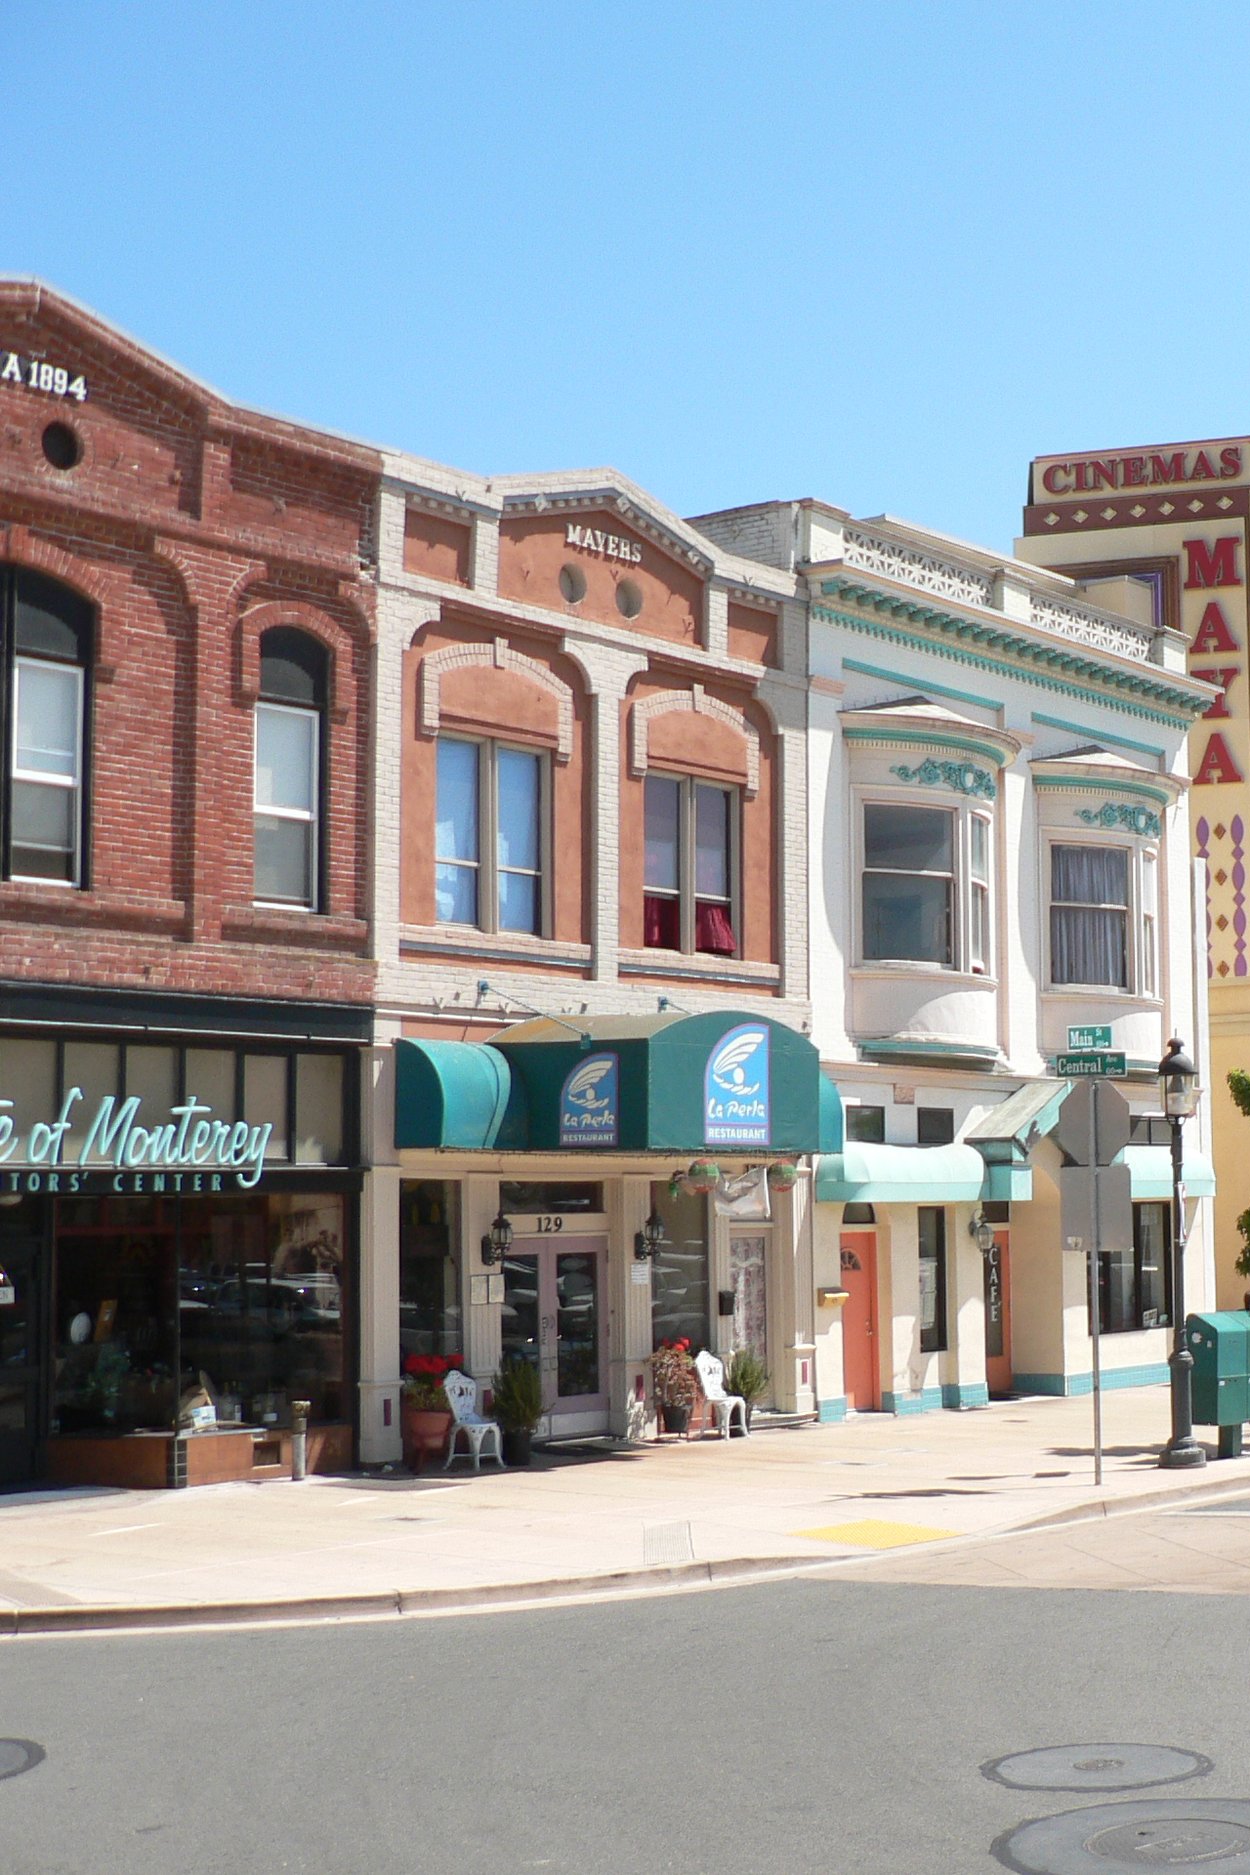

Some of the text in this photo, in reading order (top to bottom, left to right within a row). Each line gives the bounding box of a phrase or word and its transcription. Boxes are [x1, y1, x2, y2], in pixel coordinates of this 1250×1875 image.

[2, 352, 87, 402] A 1894
[1042, 447, 1243, 494] CINEMAS
[566, 522, 642, 563] MAYERS
[1182, 536, 1244, 785] MAYA
[1070, 1030, 1093, 1046] Main
[1058, 1057, 1102, 1073] Central
[707, 1098, 765, 1118] La Perla
[564, 1110, 615, 1128] La Perla
[27, 1086, 84, 1166] of
[78, 1095, 273, 1188] Monterey
[562, 1133, 614, 1142] RESTAURANT
[708, 1127, 766, 1140] RESTAURANT
[113, 1173, 223, 1192] CENTER
[536, 1216, 563, 1233] 129
